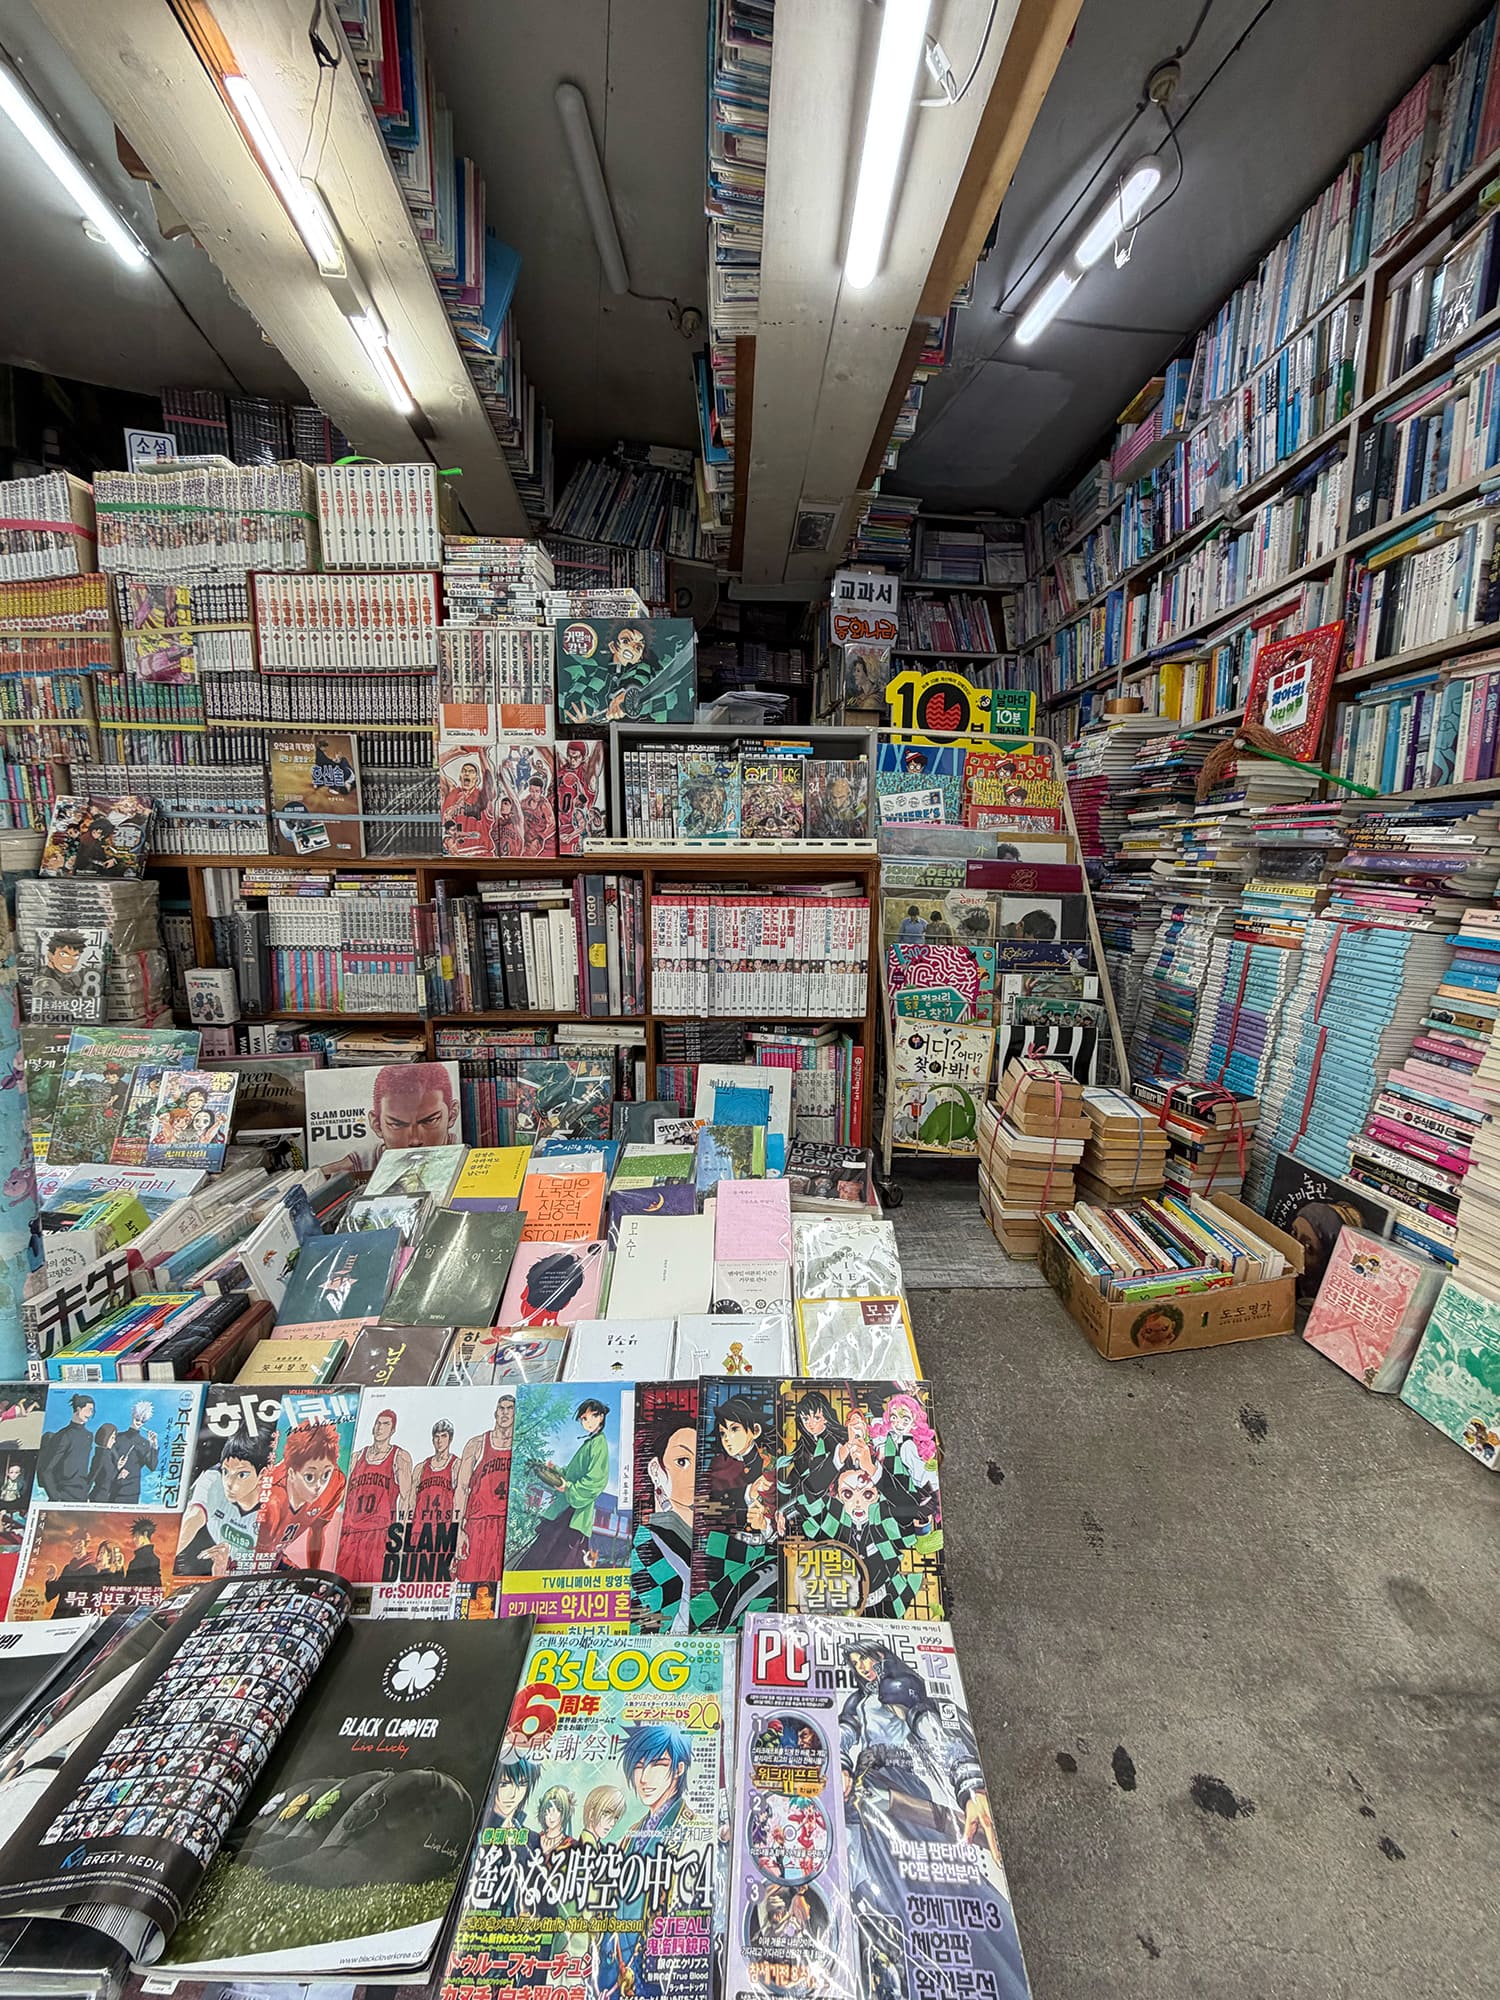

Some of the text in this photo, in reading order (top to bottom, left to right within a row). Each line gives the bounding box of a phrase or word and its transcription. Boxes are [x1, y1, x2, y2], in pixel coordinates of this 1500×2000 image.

[137, 437, 167, 456] 소설
[839, 580, 892, 604] 교과서
[834, 615, 897, 640] 동화나라
[996, 693, 1028, 708] 날마다
[995, 709, 1021, 724] 10분
[312, 765, 345, 786] 호신술
[808, 782, 820, 794] 34
[885, 865, 925, 876] JOHN
[885, 876, 961, 887] GREATEST
[586, 895, 597, 927] LOGO
[70, 998, 100, 1019] 완결!
[908, 1033, 984, 1063] 어디? 어디?
[914, 1056, 969, 1080] 찾아봐!
[310, 1108, 366, 1120] SLAM DUNK
[311, 1123, 367, 1142] PLUS
[791, 1149, 858, 1162] DESIGN
[794, 1142, 863, 1155] TATTOO
[789, 1156, 843, 1168] BOOK
[90, 1177, 177, 1193] 추억의 마니
[538, 1199, 581, 1221] 집중력
[206, 1394, 351, 1437] 하이큐!!
[162, 1407, 192, 1510] 주술회전
[494, 1481, 507, 1500] 4
[356, 1494, 376, 1514] 10
[425, 1494, 441, 1511] 14
[390, 1509, 461, 1519] THE FIRST
[281, 1524, 301, 1542] 21
[386, 1521, 460, 1553] SLAM
[382, 1552, 454, 1583] DUNK
[798, 1549, 857, 1578] 귀멸의
[379, 1584, 450, 1598] re:SOURCE
[542, 1575, 601, 1588] TV애니메이션
[65, 1591, 125, 1607] 특급 정보로
[806, 1578, 849, 1609] 칼날
[508, 1592, 631, 1619] 인기 시리즈 약사의 혼
[919, 1635, 943, 1646] 1999
[757, 1629, 811, 1682] PC
[922, 1653, 952, 1680] 12
[625, 1702, 721, 1730] ニンテンドーDS 20
[338, 1717, 385, 1736] BLACK
[376, 1738, 410, 1760] Lucky
[758, 1766, 819, 1782] 워크래프트
[82, 1853, 166, 1873] GREAT MEDIA
[907, 1896, 1001, 1929] 창세기전 3
[541, 1917, 566, 1933] Girl's
[566, 1917, 587, 1932] Side
[588, 1917, 608, 1932] 2nd
[608, 1918, 644, 1933] Season
[653, 1915, 711, 1936] STEAL!
[909, 1930, 972, 1964] 체험판
[672, 1972, 689, 1980] True
[689, 1972, 709, 1980] Blood
